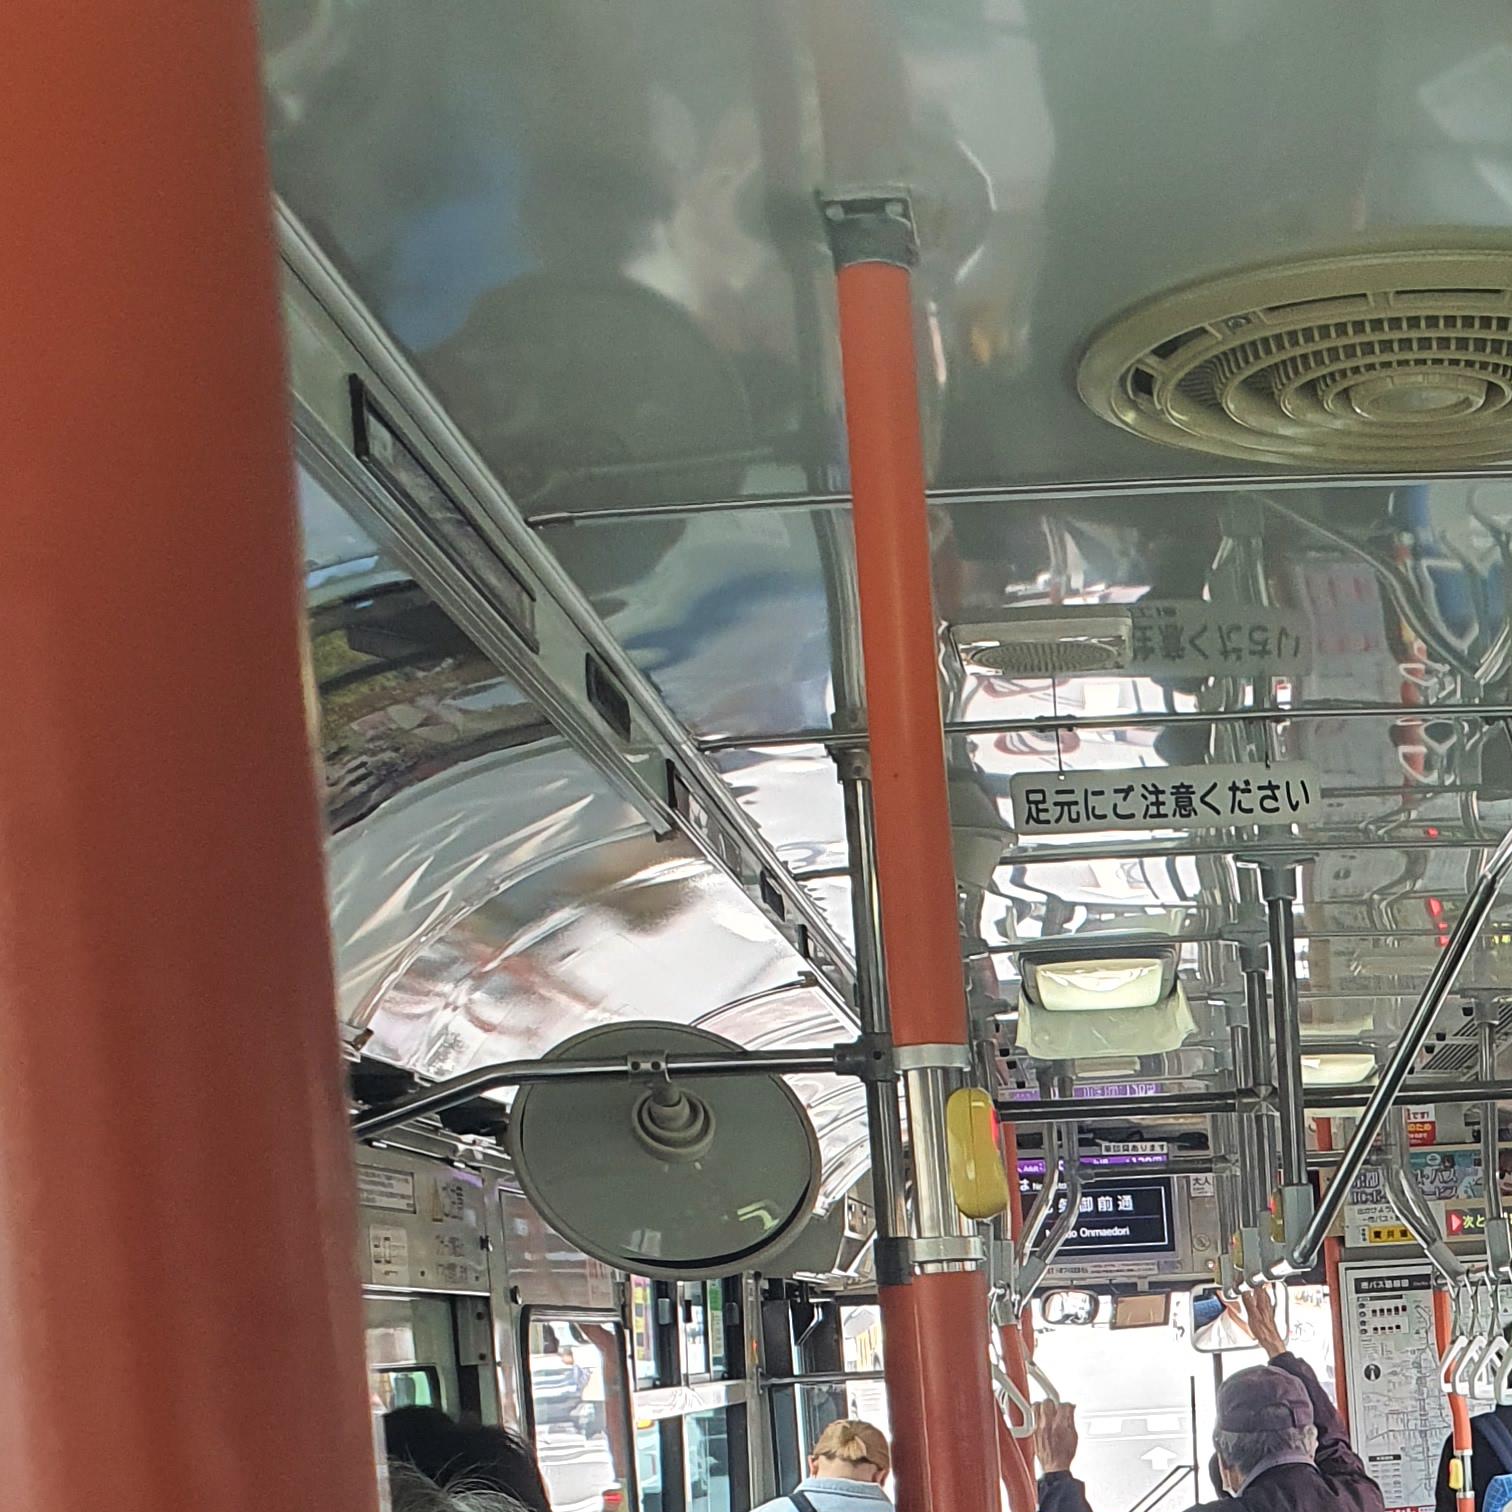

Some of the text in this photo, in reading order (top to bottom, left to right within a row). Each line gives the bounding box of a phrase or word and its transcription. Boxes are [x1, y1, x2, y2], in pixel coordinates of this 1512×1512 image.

[1024, 778, 1309, 826] 足元にご注意ください
